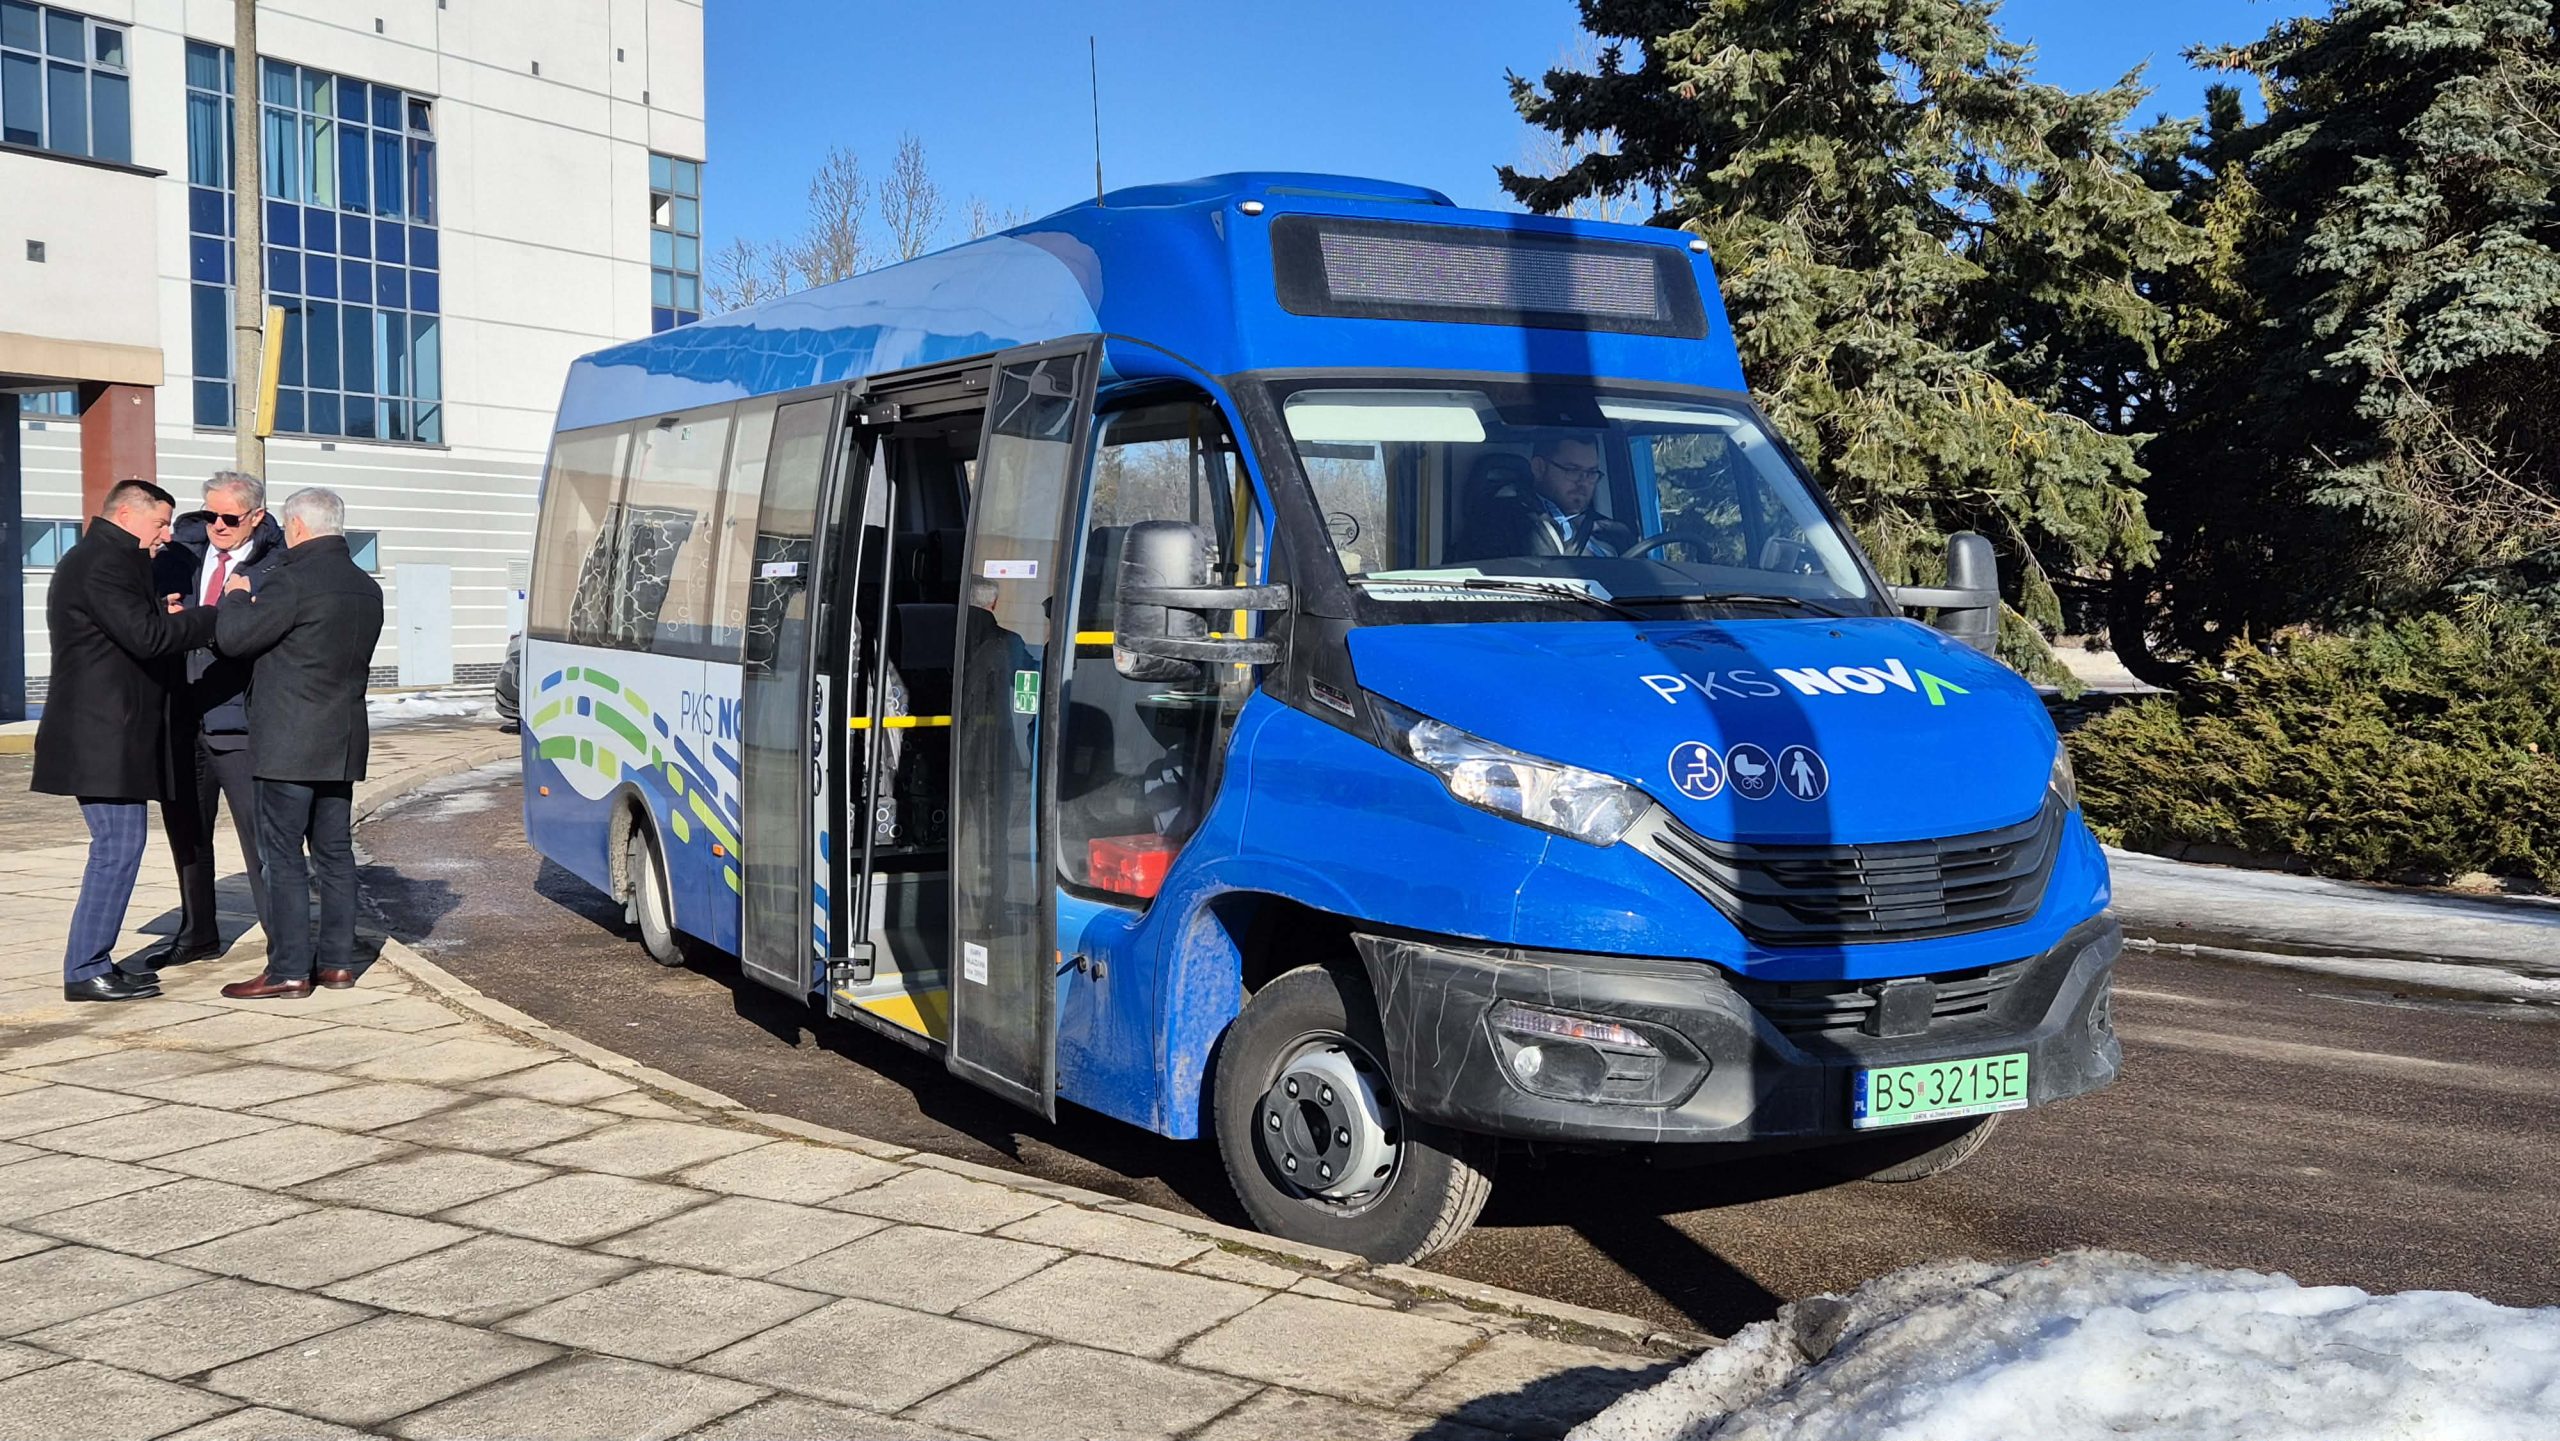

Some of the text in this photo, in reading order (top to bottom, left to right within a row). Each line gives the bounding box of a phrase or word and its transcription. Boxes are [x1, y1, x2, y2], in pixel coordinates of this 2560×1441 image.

[1639, 658, 1971, 706] PKS NOVA
[681, 690, 743, 743] PKS NO
[1854, 1100, 1867, 1112] PL
[1875, 1071, 1915, 1112] BS
[1929, 1059, 2019, 1106] 3215E
